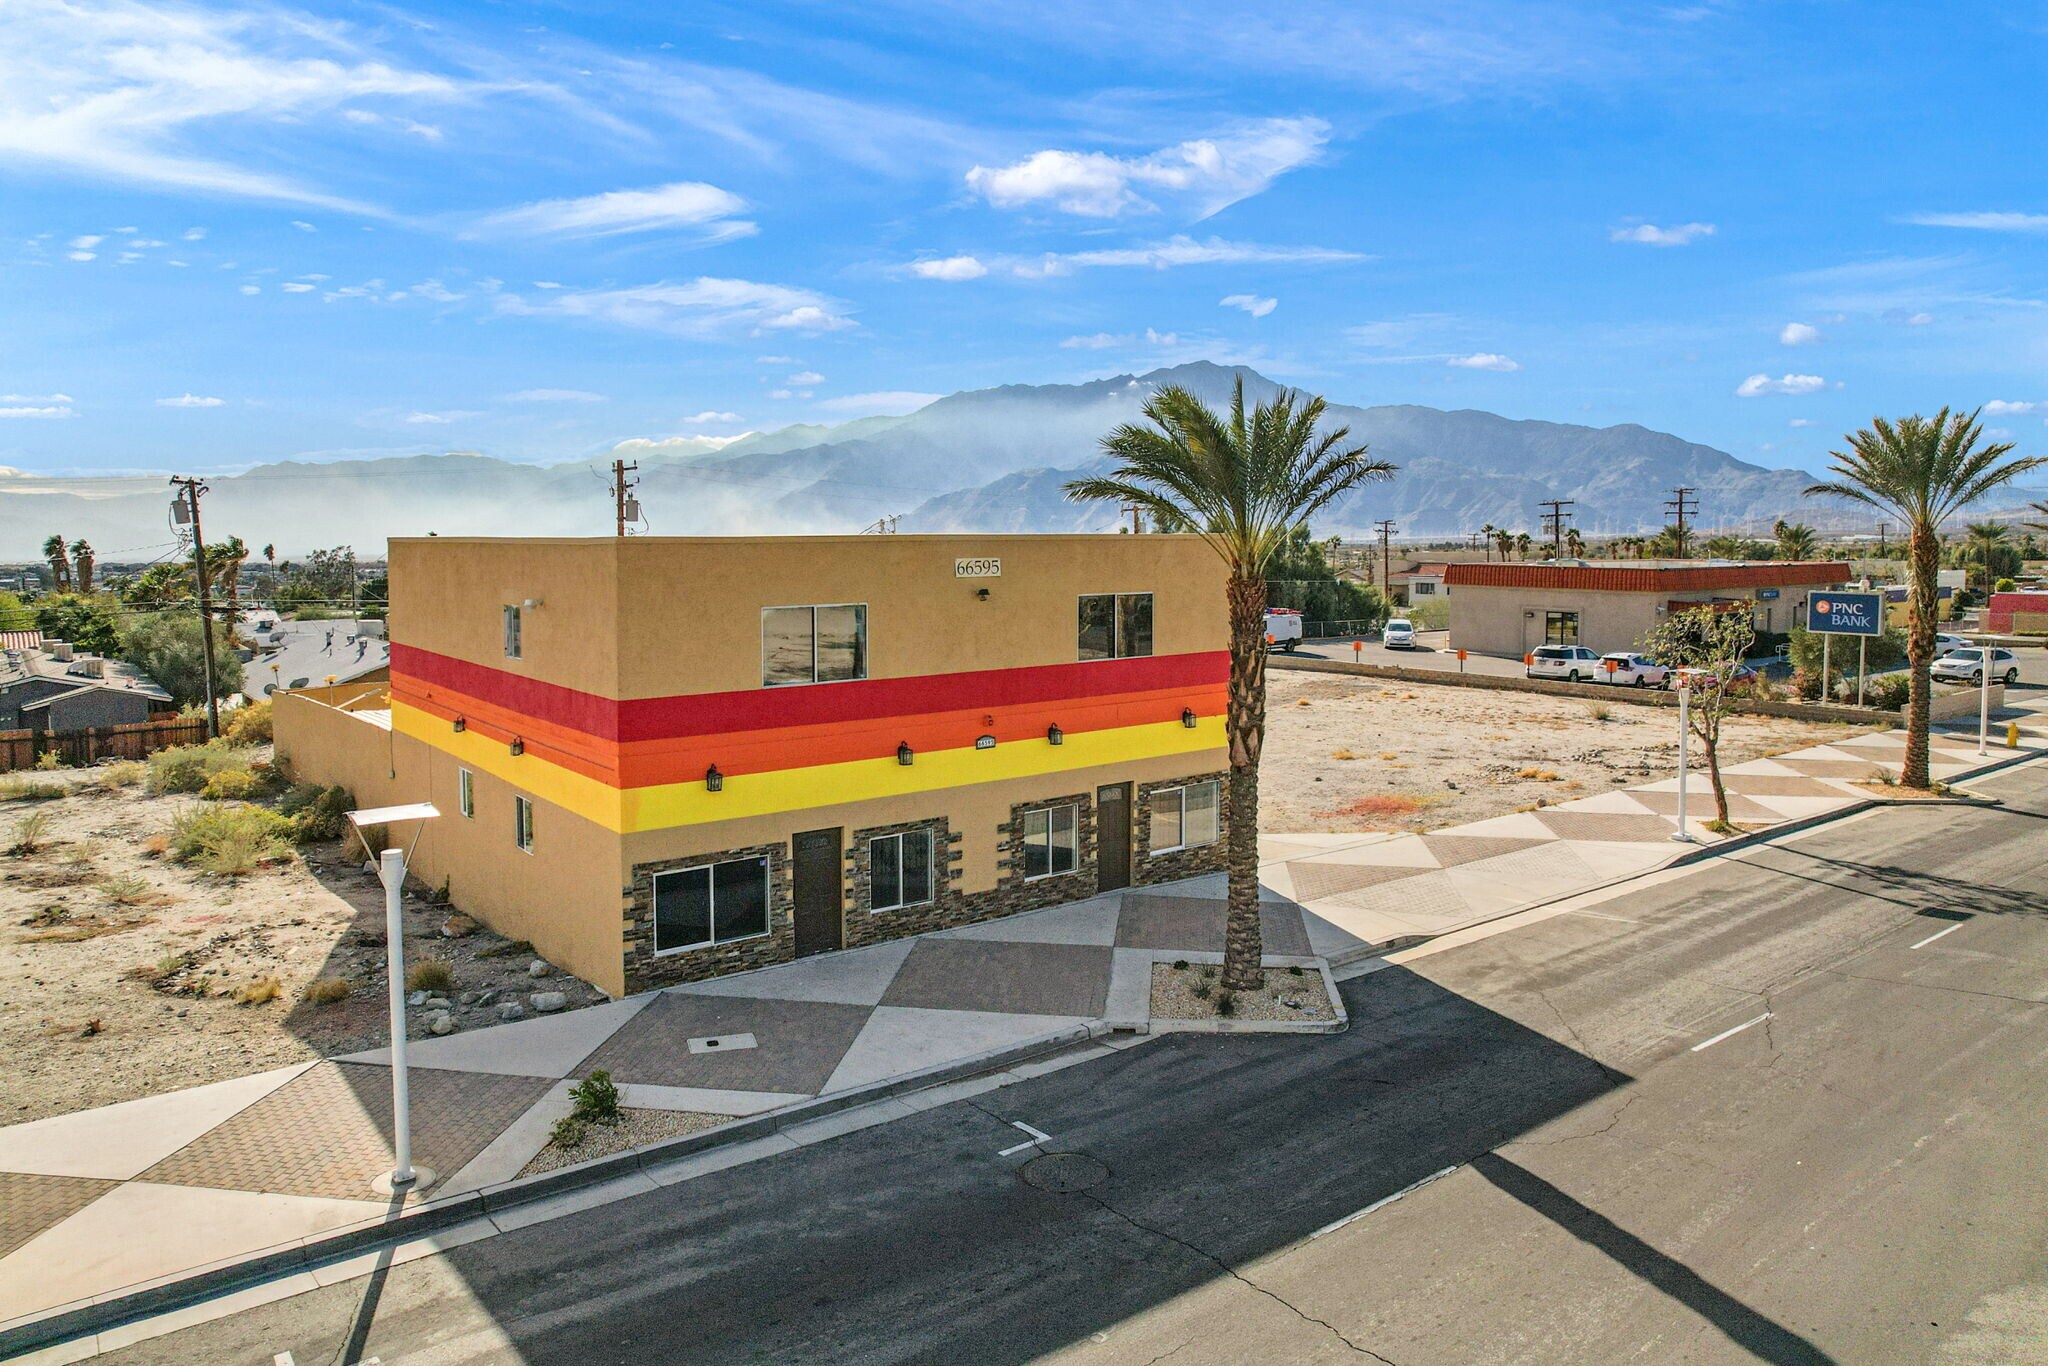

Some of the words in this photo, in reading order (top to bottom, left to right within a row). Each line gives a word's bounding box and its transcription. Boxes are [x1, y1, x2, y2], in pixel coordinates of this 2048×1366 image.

[957, 560, 999, 575] 66595
[1832, 602, 1863, 615] PNC
[1831, 614, 1870, 627] BANK
